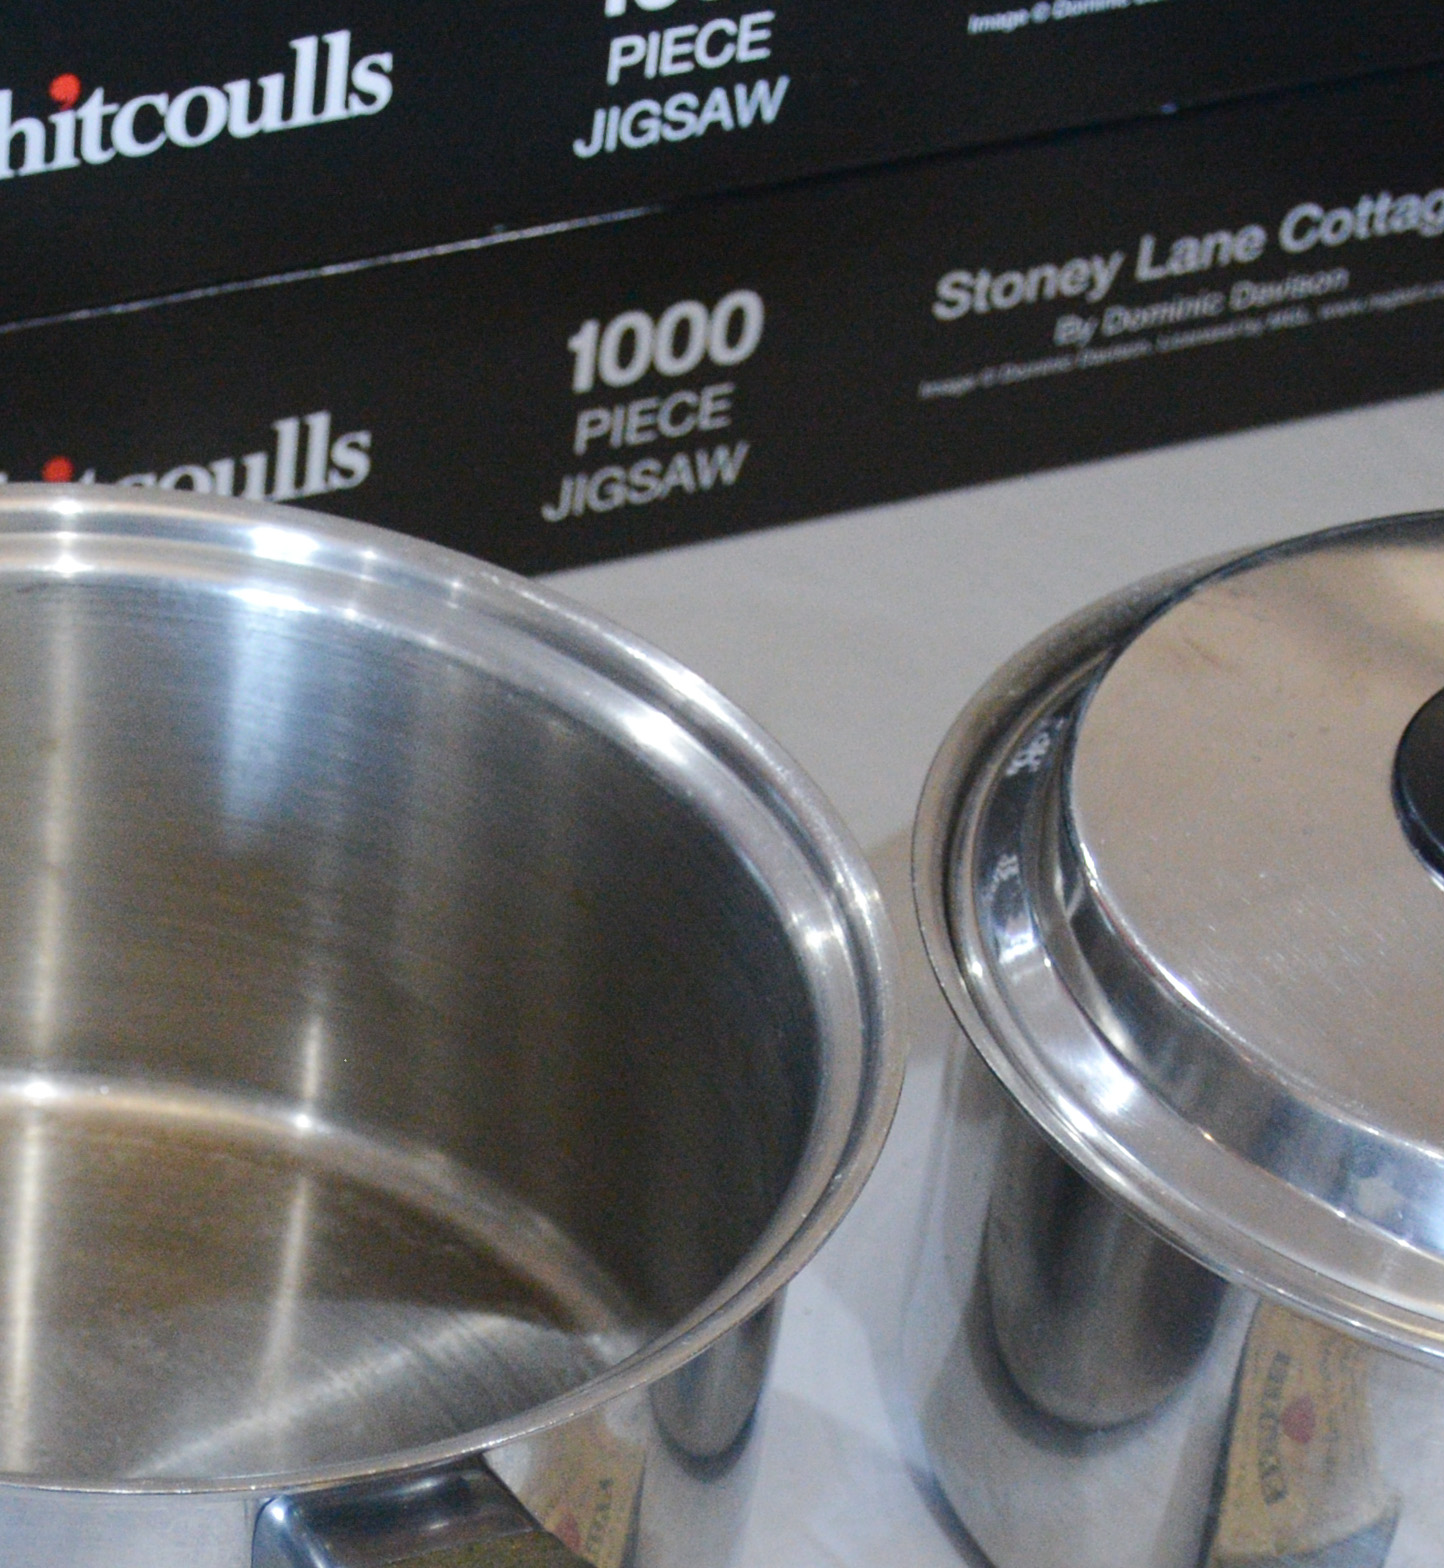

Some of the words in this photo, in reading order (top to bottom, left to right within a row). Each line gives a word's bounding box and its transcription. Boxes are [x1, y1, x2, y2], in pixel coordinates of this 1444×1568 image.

[606, 10, 776, 86] PIECE
[572, 74, 791, 158] JIGSAW
[931, 250, 1125, 321] Stoney
[1134, 223, 1268, 282] Lane
[567, 288, 765, 394] 1000
[1053, 312, 1097, 348] By
[1101, 287, 1224, 337] Dominic
[573, 381, 737, 456] PIECE
[540, 440, 752, 523] JIGSAW
